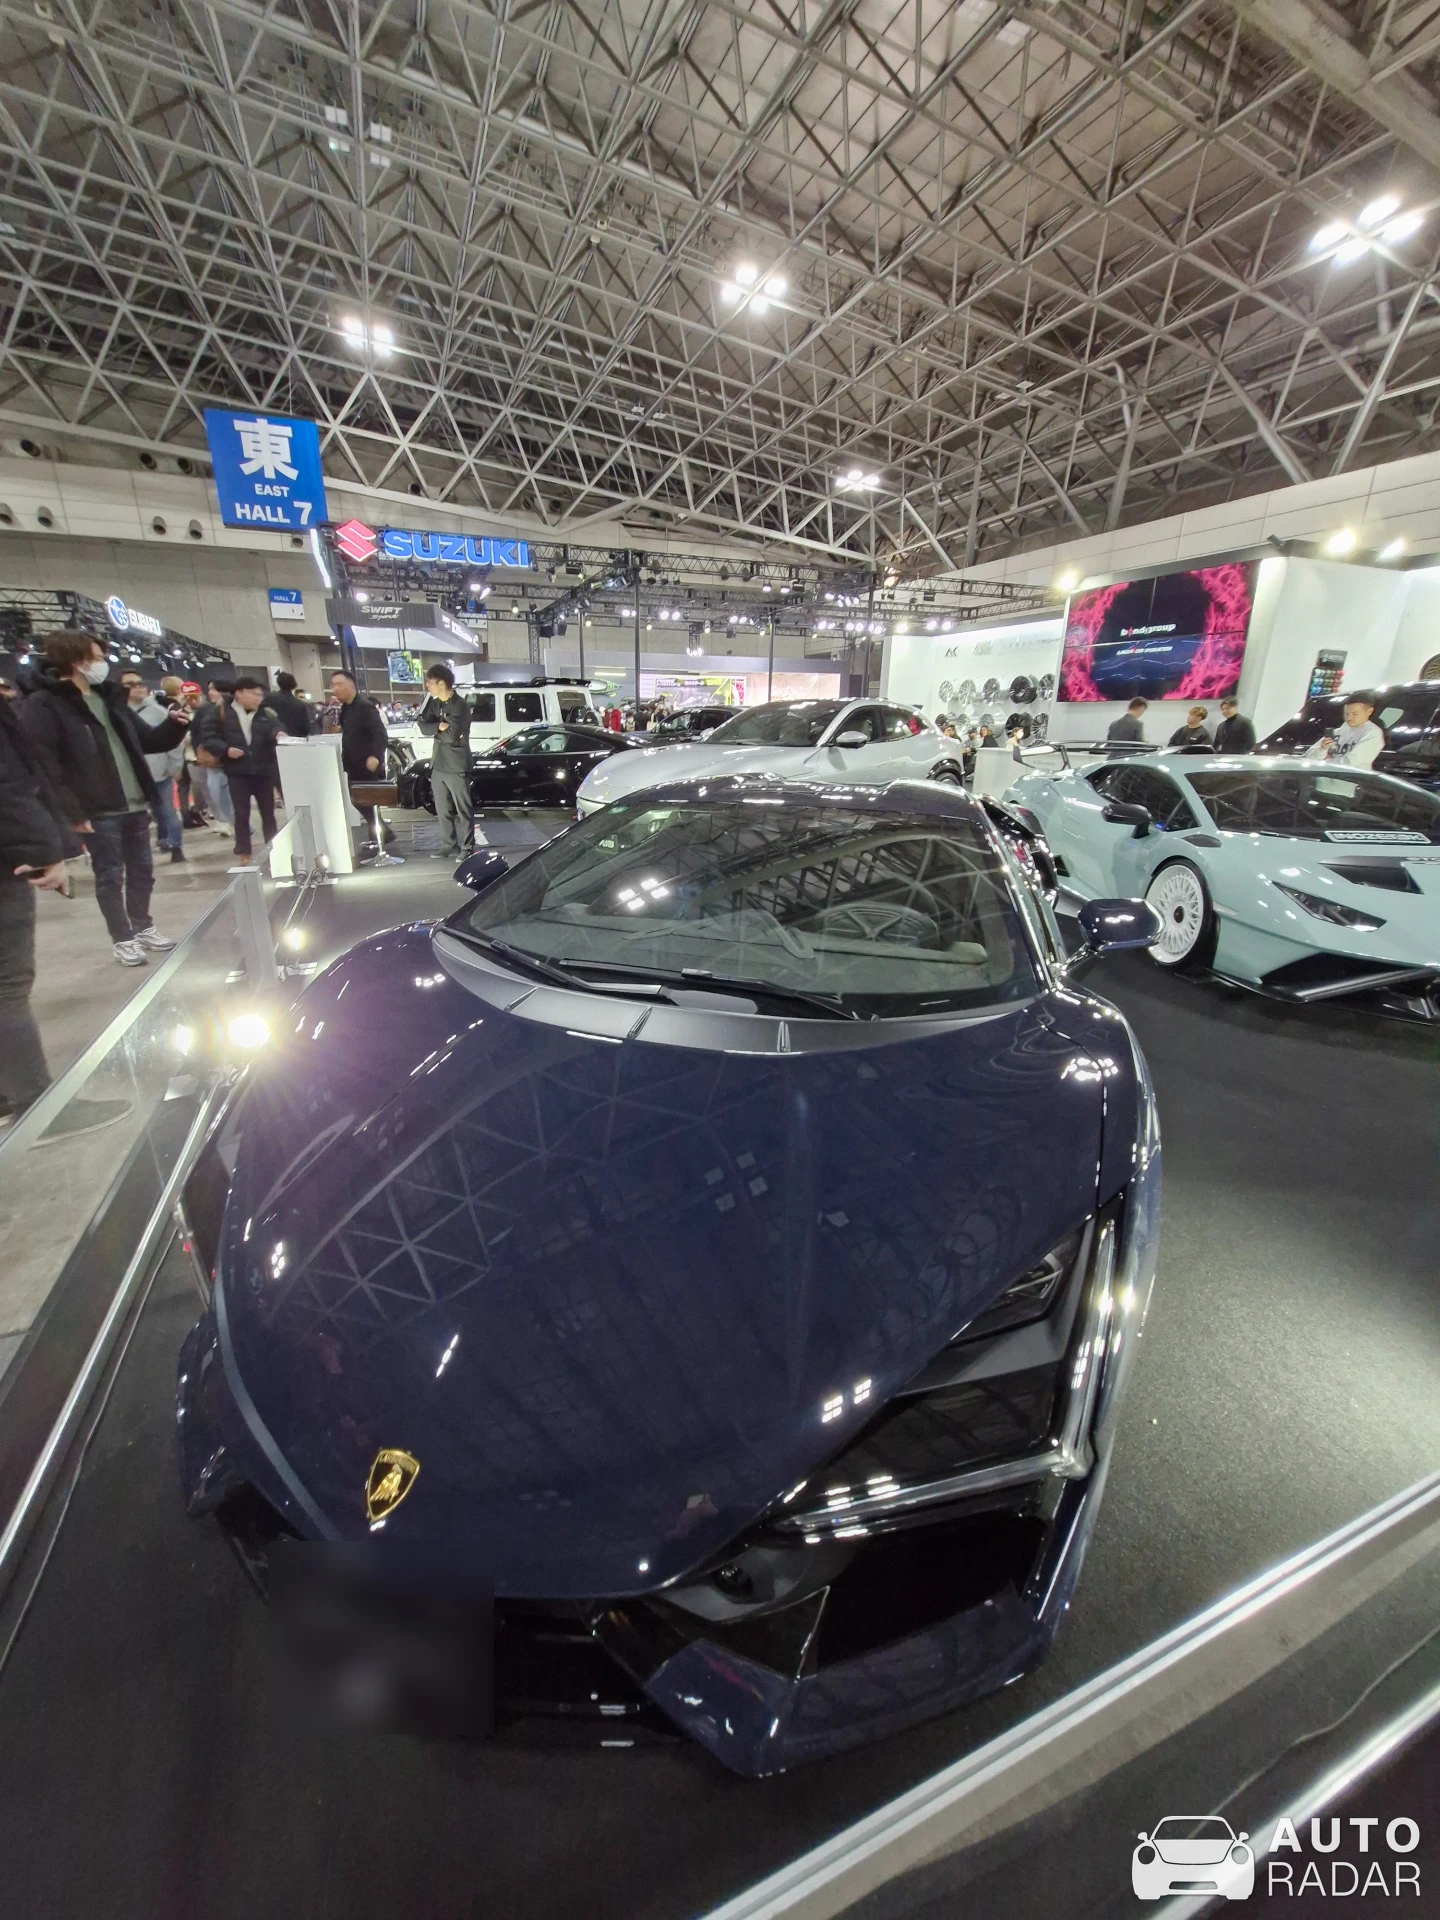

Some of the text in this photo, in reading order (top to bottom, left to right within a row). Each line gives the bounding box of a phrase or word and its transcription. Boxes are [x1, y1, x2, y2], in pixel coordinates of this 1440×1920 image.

[233, 418, 299, 481] 東
[254, 483, 290, 498] EAST
[234, 500, 313, 526] HALL 7
[383, 528, 530, 569] SUZUKI
[289, 591, 297, 602] 7
[360, 605, 403, 615] SWIFT
